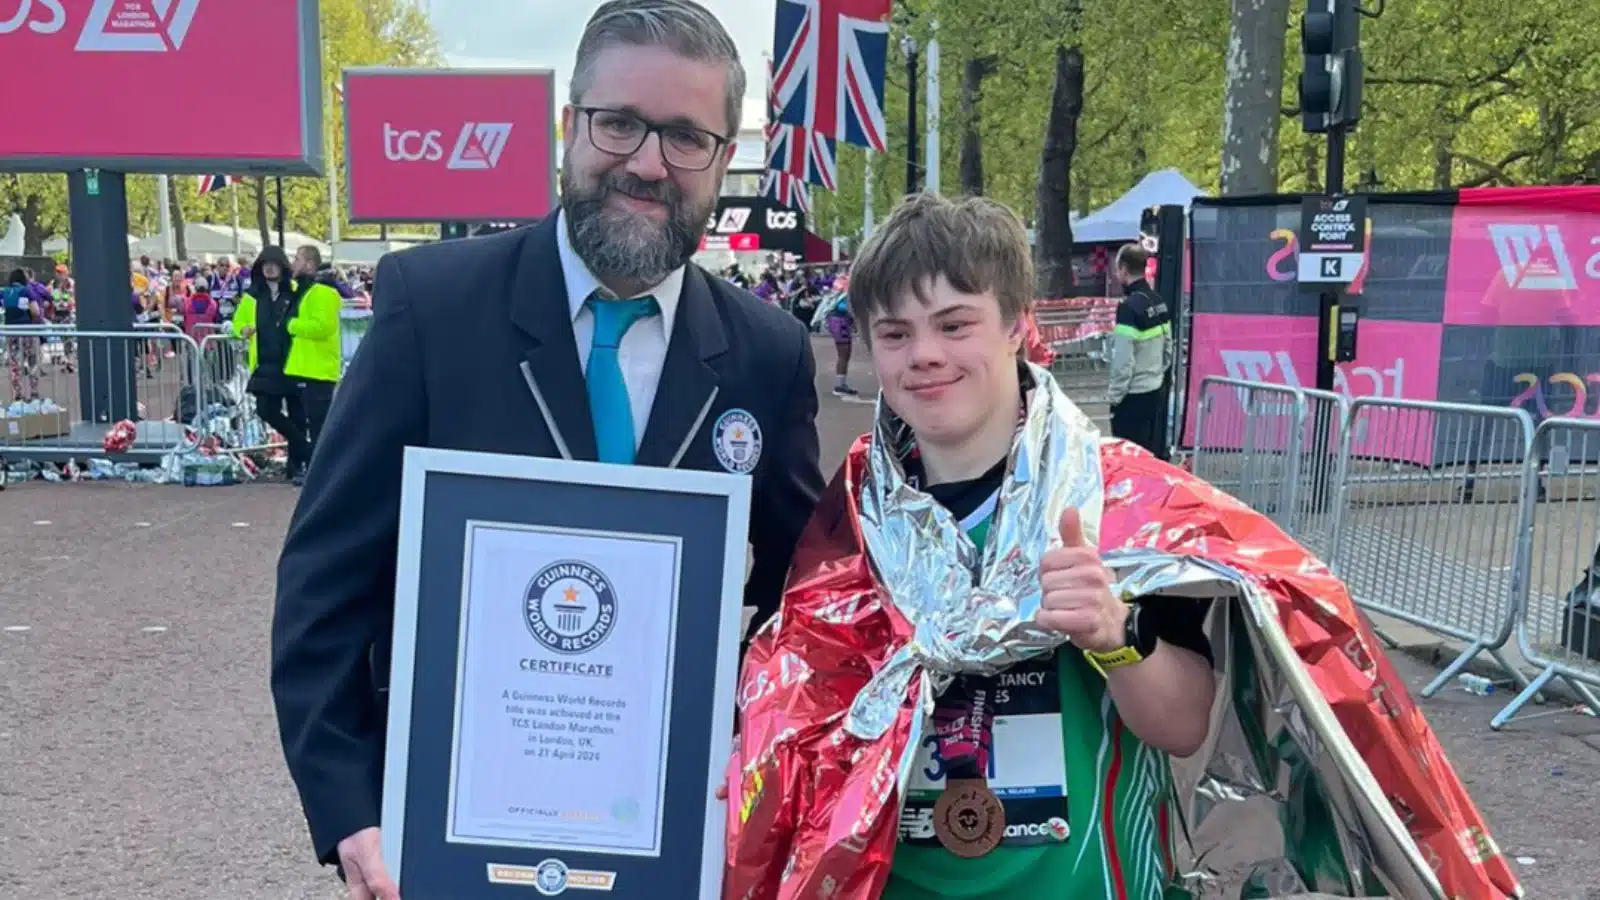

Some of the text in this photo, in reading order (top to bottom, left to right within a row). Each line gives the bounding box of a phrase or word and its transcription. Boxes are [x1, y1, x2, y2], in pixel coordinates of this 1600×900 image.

[1313, 213, 1352, 222] ACCESS
[1310, 222, 1356, 232] CONTROL
[1318, 231, 1347, 241] POINT
[1324, 259, 1338, 275] K
[537, 565, 607, 593] GUINNESS
[528, 598, 613, 649] WORLD RECORDS
[519, 658, 613, 677] CERTIFICATE
[998, 671, 1046, 687] TANCY
[501, 689, 626, 708] A Guinness World Records
[505, 705, 621, 721] title was achieved at the
[511, 718, 614, 735] TCS London Marathon
[528, 733, 537, 743] in
[524, 749, 535, 757] on
[538, 748, 549, 758] 21
[551, 749, 575, 760] April
[1002, 822, 1050, 838] ance
